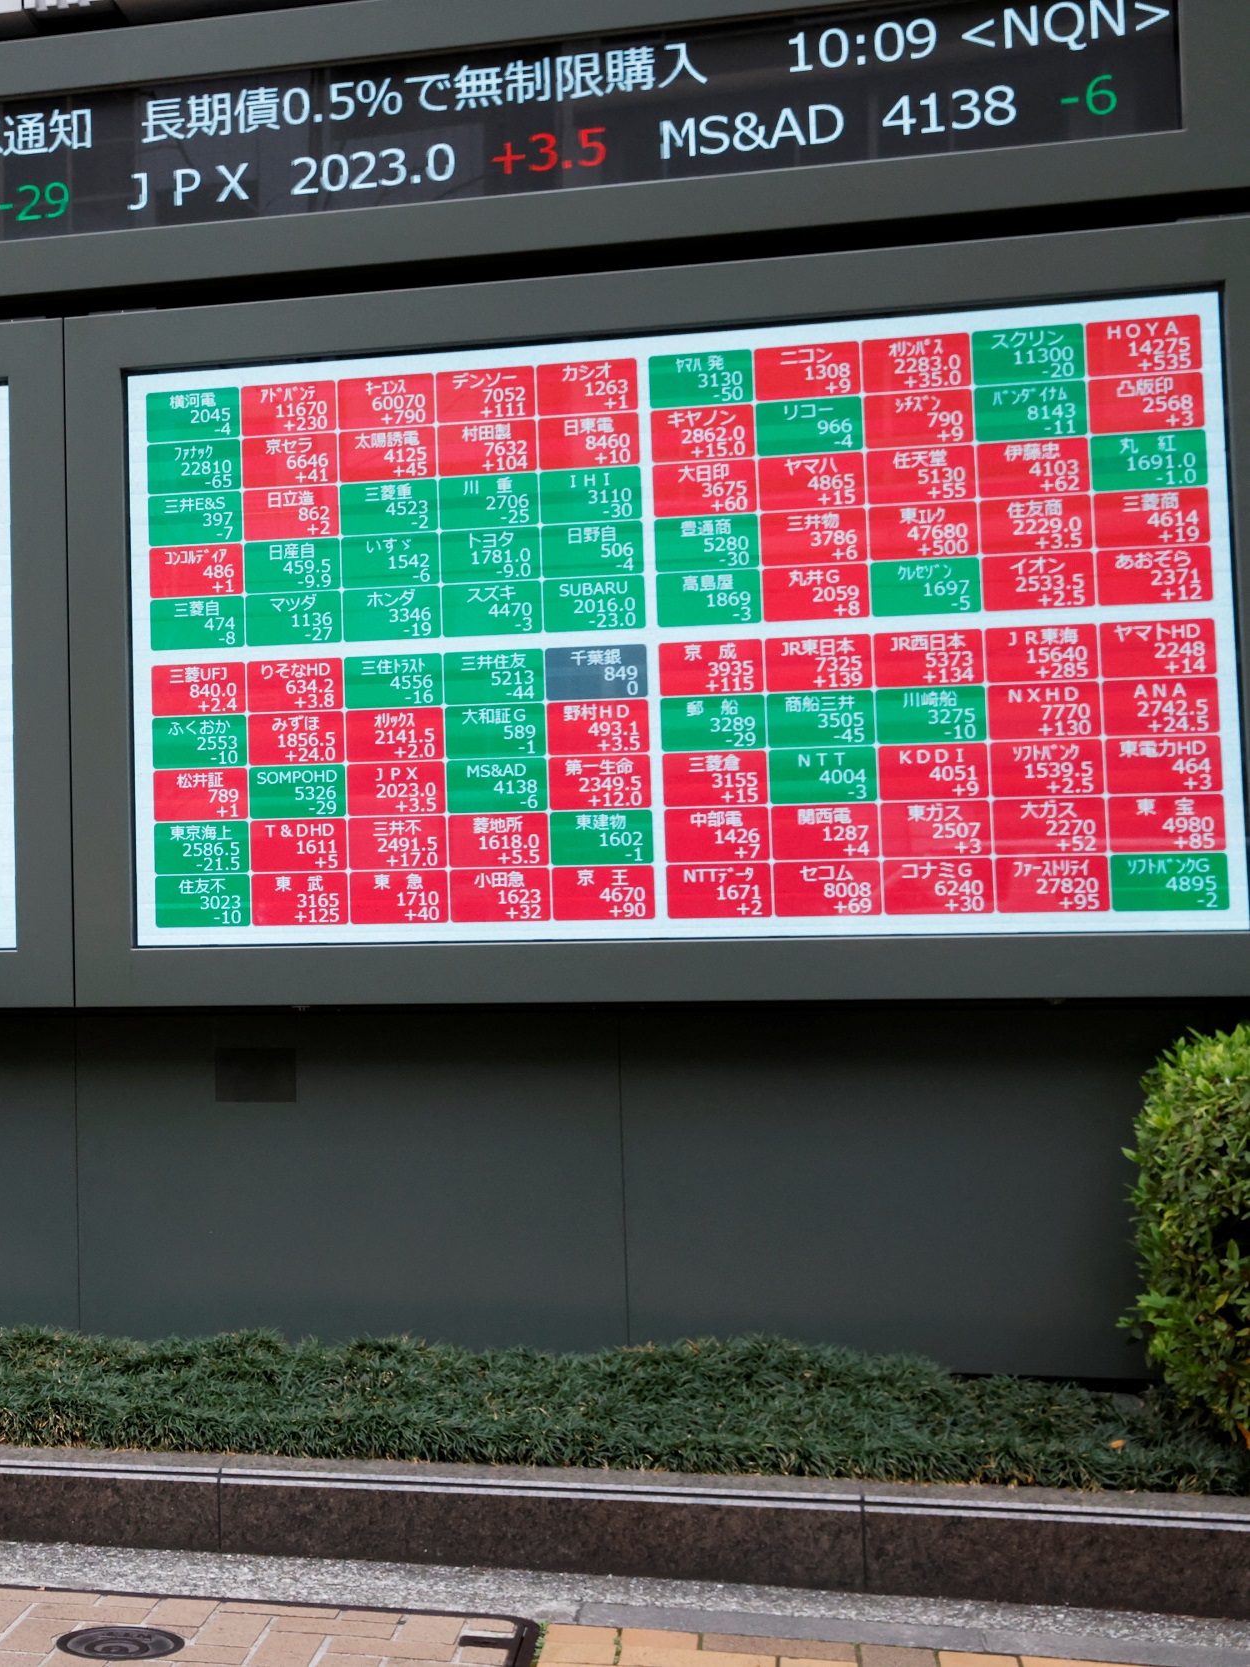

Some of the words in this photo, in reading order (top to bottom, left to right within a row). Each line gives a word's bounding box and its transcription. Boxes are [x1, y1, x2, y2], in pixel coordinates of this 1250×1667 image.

[142, 43, 708, 144] 長期債0.5%で無制限購入
[789, 19, 936, 72] 10:09
[962, 0, 1169, 50] <NQN>
[0, 182, 68, 220] -29
[291, 143, 455, 195] 2023.0
[493, 128, 606, 174] +3.5
[660, 104, 844, 159] MS&AD
[883, 85, 1016, 135] 4138
[1062, 75, 1116, 114] -6
[991, 330, 1064, 349] スクリン
[1014, 345, 1074, 365] 11300
[562, 362, 612, 382] カシオ
[1042, 361, 1074, 378] -20
[452, 372, 517, 390] デンソー
[585, 378, 628, 397] 1263
[482, 386, 526, 404] 7052
[603, 394, 628, 409] +1
[480, 401, 525, 418] +111
[667, 409, 736, 428] キヤノン
[783, 403, 833, 421] リコー
[681, 425, 745, 444] 2862.0
[817, 417, 853, 435] 966
[265, 437, 312, 455] 京セラ
[690, 440, 746, 458] +15.0
[833, 433, 853, 448] -4
[286, 452, 328, 470] 6646
[892, 448, 947, 469] 任天堂
[294, 467, 328, 483] +41
[917, 466, 966, 487] 5130
[927, 485, 966, 499] +55
[164, 496, 226, 514] 三井E&S
[202, 511, 233, 530] 397
[216, 529, 233, 540] -7
[469, 530, 514, 549] トヨタ
[471, 547, 531, 565] 1781.0
[1114, 549, 1191, 570] あおぞら
[496, 562, 531, 578] -9.0
[1150, 567, 1201, 586] 2371
[559, 580, 628, 597] SUBARU
[1161, 583, 1202, 601] +12
[573, 596, 636, 614] 2016.0
[589, 611, 636, 628] -23.0
[1114, 623, 1200, 642] ヤマトHD
[780, 638, 855, 656] JR東日本
[1154, 640, 1206, 658] 2248
[261, 662, 331, 680] りそなHD
[814, 655, 862, 672] 7325
[1164, 656, 1206, 674] +14
[285, 678, 334, 694] 634.2
[813, 670, 863, 688] +139
[294, 692, 334, 708] +3.8
[167, 719, 231, 736] ふくおか
[196, 735, 238, 751] 2553
[1118, 739, 1207, 758] 東電力HD
[210, 749, 238, 764] -10
[1171, 757, 1211, 774] 464
[256, 769, 338, 785] SOMPOHD
[1183, 773, 1212, 790] +3
[294, 785, 336, 801] 5326
[308, 800, 337, 815] -29
[170, 824, 232, 841] 東京海上
[182, 841, 240, 857] 2586.5
[196, 856, 240, 871] -21.5
[799, 864, 854, 882] セコム
[823, 881, 872, 898] 8008
[833, 897, 872, 914] +69
